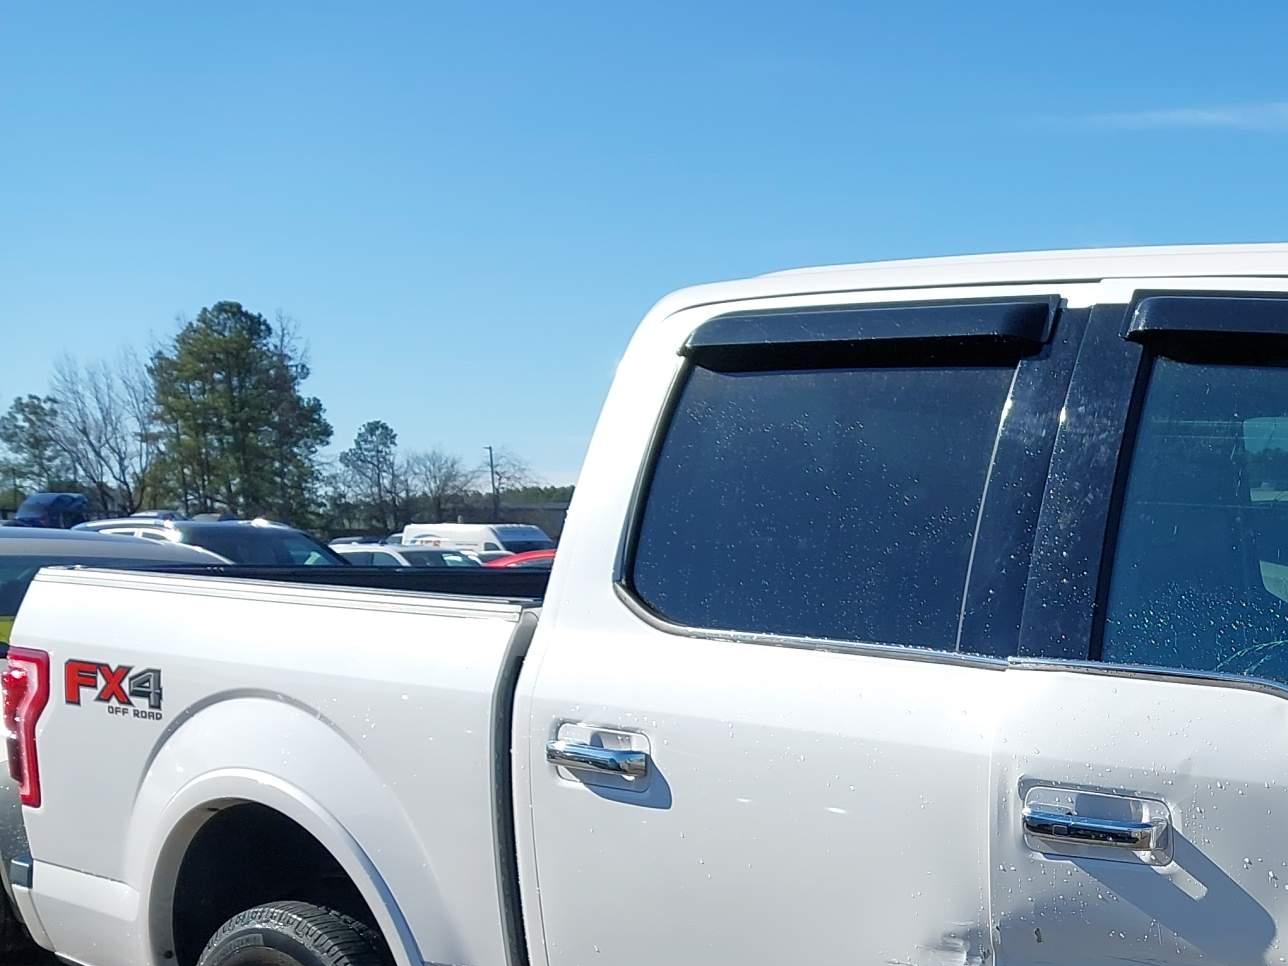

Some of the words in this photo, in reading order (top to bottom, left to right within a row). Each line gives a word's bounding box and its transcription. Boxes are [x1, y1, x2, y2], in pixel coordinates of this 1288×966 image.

[64, 658, 163, 711] FX4
[107, 705, 129, 717] OFF
[133, 708, 163, 721] ROAD
